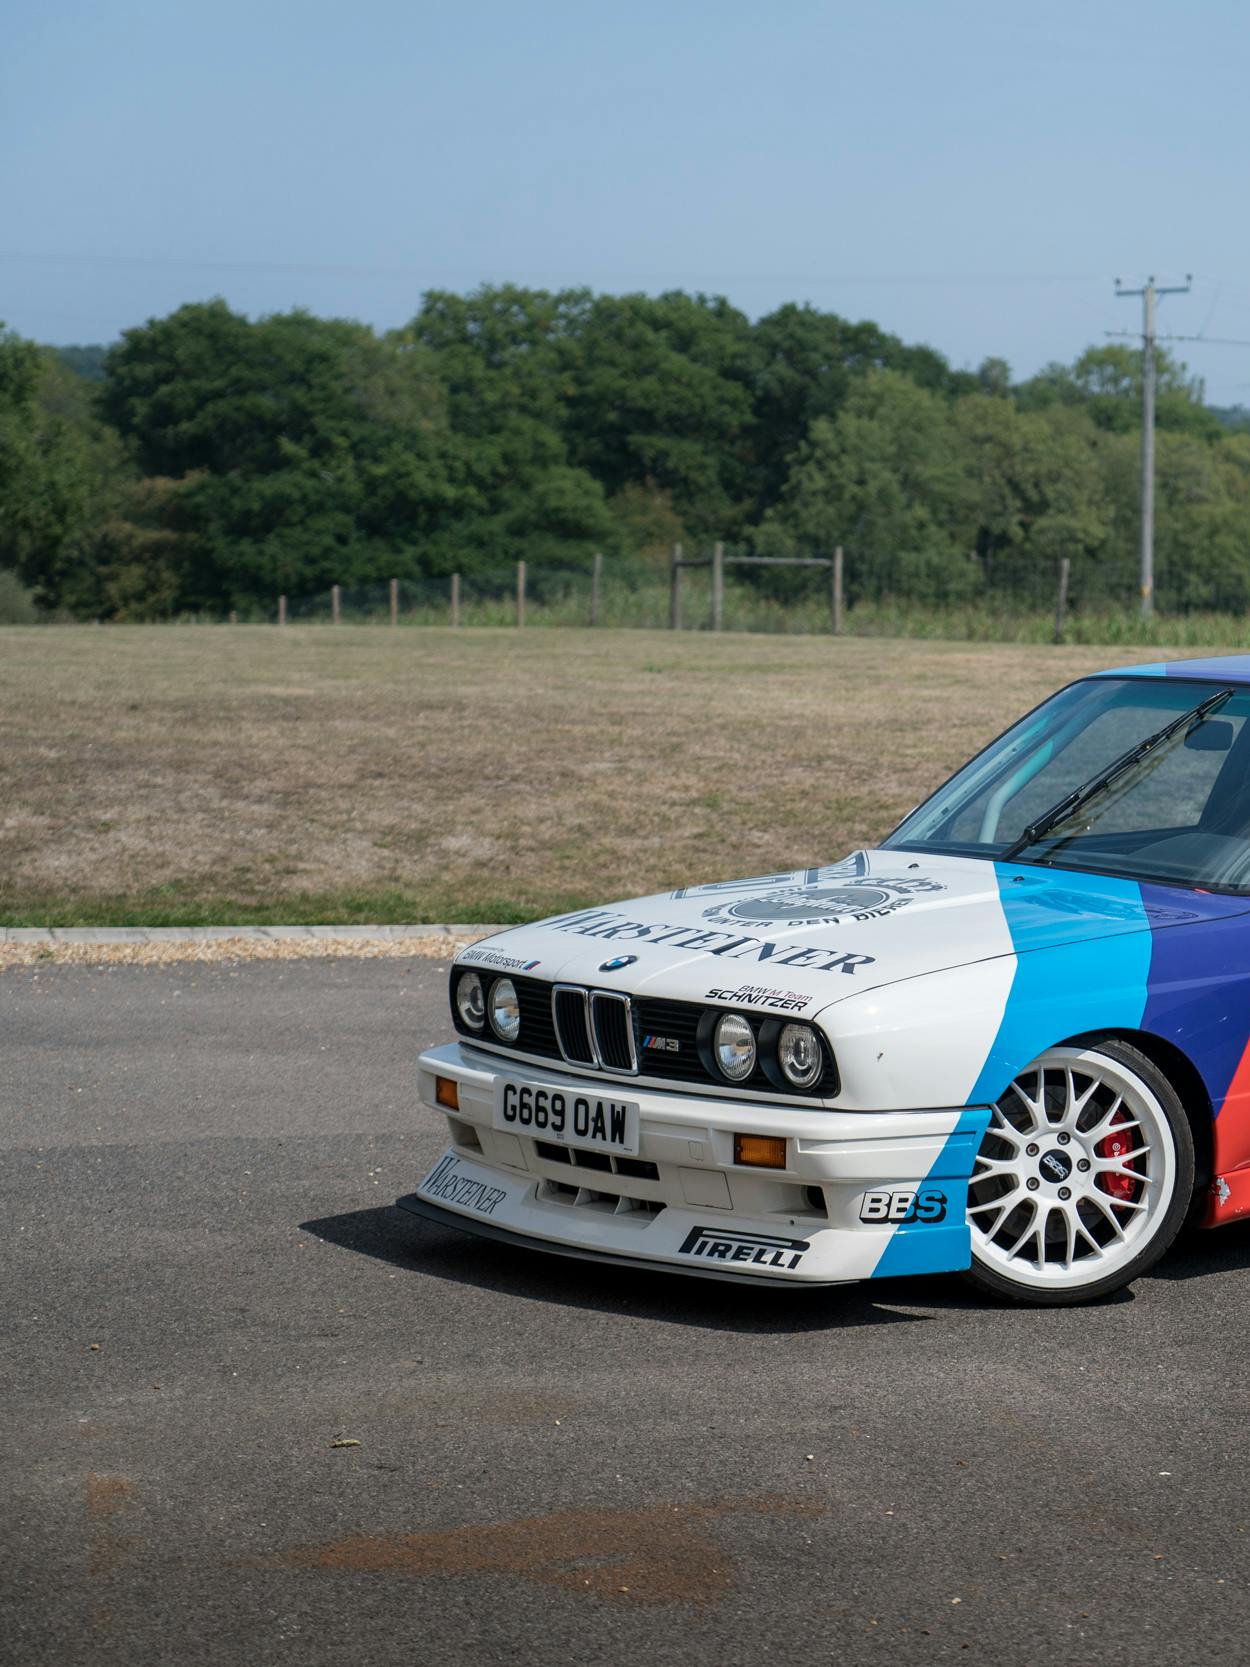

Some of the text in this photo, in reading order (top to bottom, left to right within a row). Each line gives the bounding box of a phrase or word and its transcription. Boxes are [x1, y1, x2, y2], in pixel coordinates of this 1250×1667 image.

[788, 917, 840, 926] DEN
[536, 910, 876, 976] WARSTEINER
[705, 988, 808, 1011] SCHNITZER
[738, 985, 771, 995] BMW
[784, 991, 813, 1001] Team
[653, 1037, 679, 1052] M3
[503, 1084, 626, 1144] G669 OAW
[1043, 1155, 1069, 1179] BBS
[423, 1156, 507, 1215] WARSTEINER
[859, 1190, 948, 1224] BBS
[678, 1225, 811, 1270] PIRELLI
